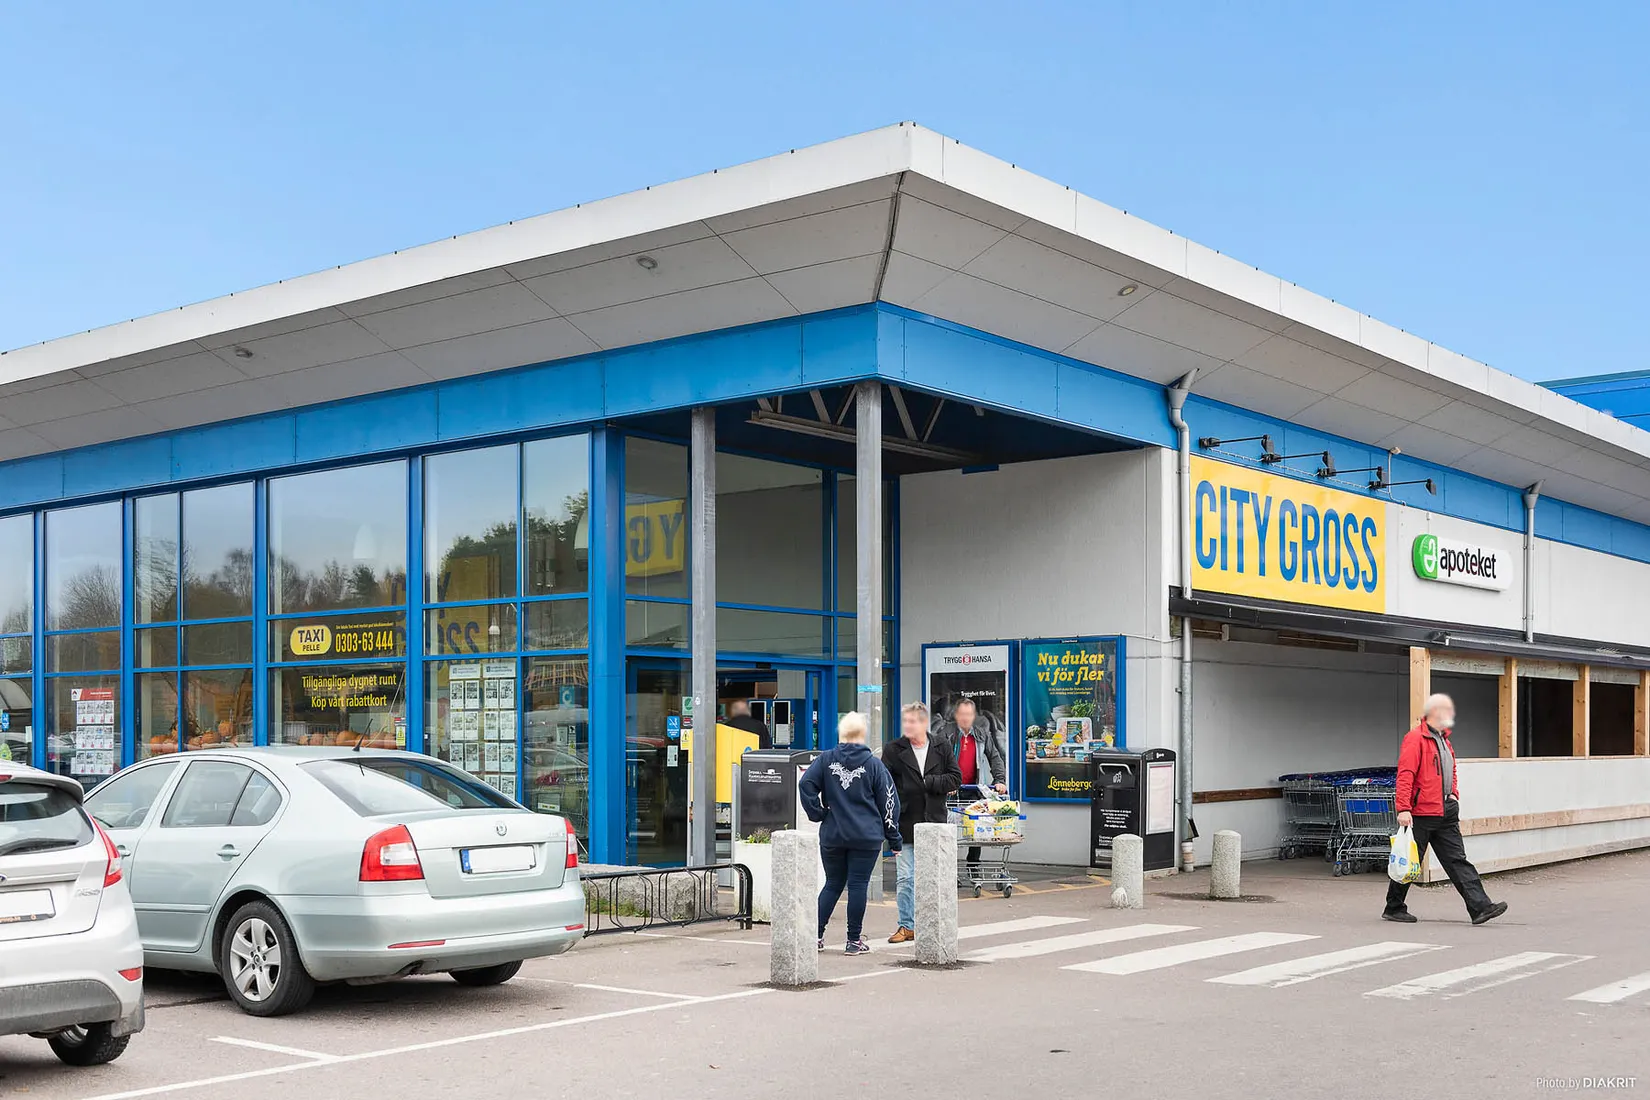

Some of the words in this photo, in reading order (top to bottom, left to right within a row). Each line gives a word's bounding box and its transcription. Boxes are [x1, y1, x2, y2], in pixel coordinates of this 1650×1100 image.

[1195, 480, 1272, 577] CITY
[1279, 499, 1378, 593] GROSS
[1440, 547, 1497, 579] apoteket
[298, 629, 325, 643] TAXI
[375, 630, 393, 651] 444
[302, 644, 320, 652] PELLE
[943, 656, 962, 664] TRYGG
[971, 655, 992, 663] HANSA
[1037, 652, 1059, 666] Nu
[1061, 649, 1105, 665] dukar
[302, 674, 347, 690] Tillgängliga
[348, 673, 377, 690] dygnet
[379, 673, 397, 686] runt
[1037, 667, 1050, 682] vi
[1051, 667, 1075, 686] för
[1075, 666, 1105, 686] fler
[311, 695, 327, 711] Köp
[328, 694, 345, 708] vårt
[346, 693, 388, 708] rabattkort
